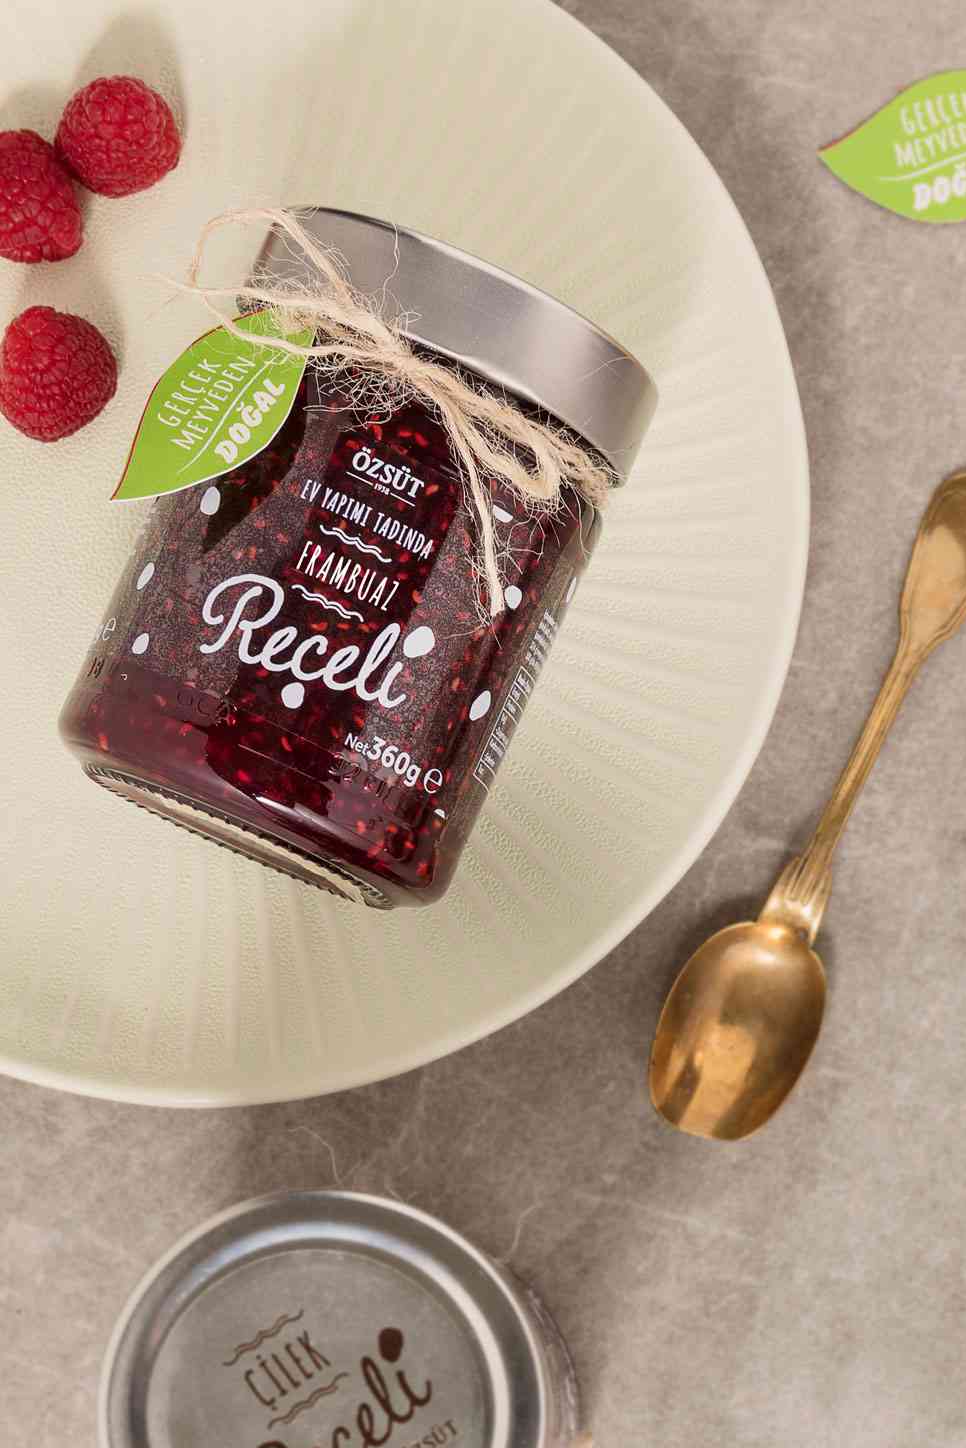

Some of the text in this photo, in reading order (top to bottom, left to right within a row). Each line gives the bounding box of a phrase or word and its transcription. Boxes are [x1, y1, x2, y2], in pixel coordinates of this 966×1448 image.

[157, 358, 222, 427] GERÇEK
[170, 356, 256, 451] MEYVEDEN
[214, 378, 286, 464] DOĞAL
[351, 446, 425, 498] ÖZSÜT
[300, 479, 434, 560] EV YAPIMI TADINDA
[296, 541, 400, 612] FRAMBUAZ
[200, 573, 435, 709] Reçeli
[244, 1330, 331, 1411] ÇİLEK
